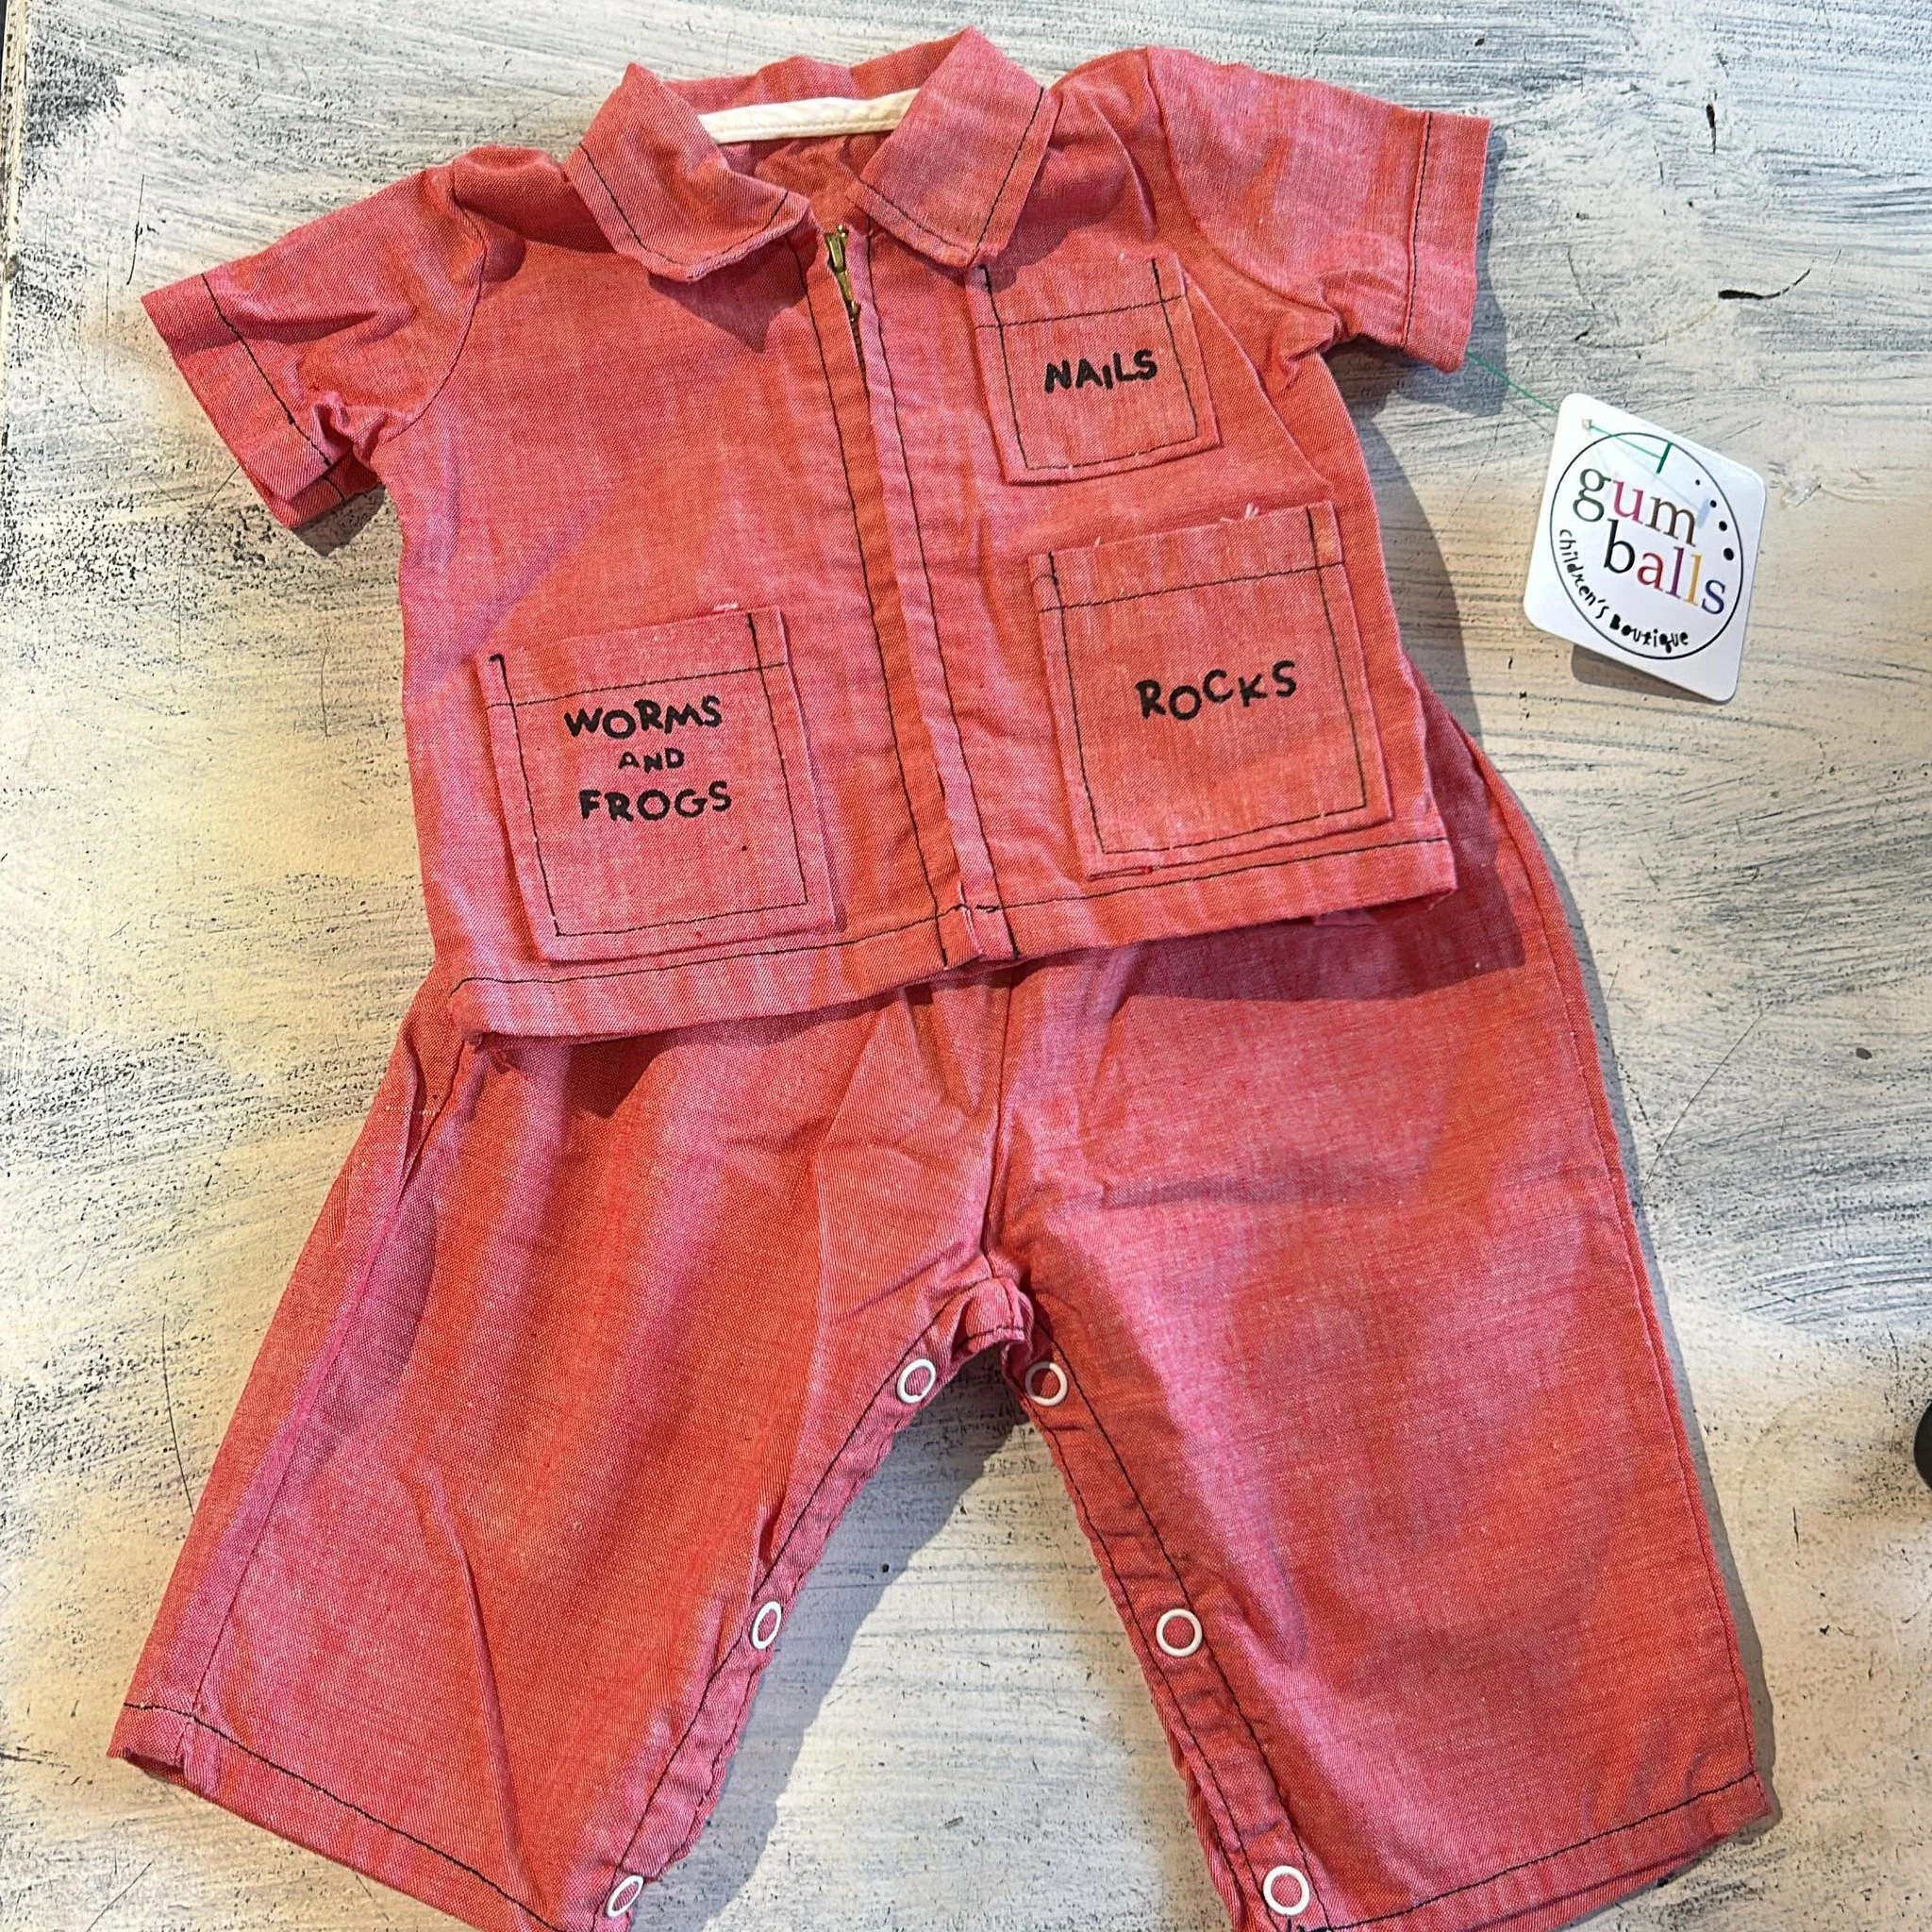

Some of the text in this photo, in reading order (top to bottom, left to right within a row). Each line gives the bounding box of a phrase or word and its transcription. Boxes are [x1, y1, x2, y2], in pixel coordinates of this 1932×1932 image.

[1044, 348, 1158, 393] NAILS
[1572, 468, 1697, 547] gum
[1558, 528, 1608, 620] children's
[1604, 518, 1726, 616] balls
[564, 694, 723, 740] WORMS
[1135, 659, 1297, 721] ROCKS
[618, 747, 686, 774] AND
[578, 780, 732, 822] FROGS
